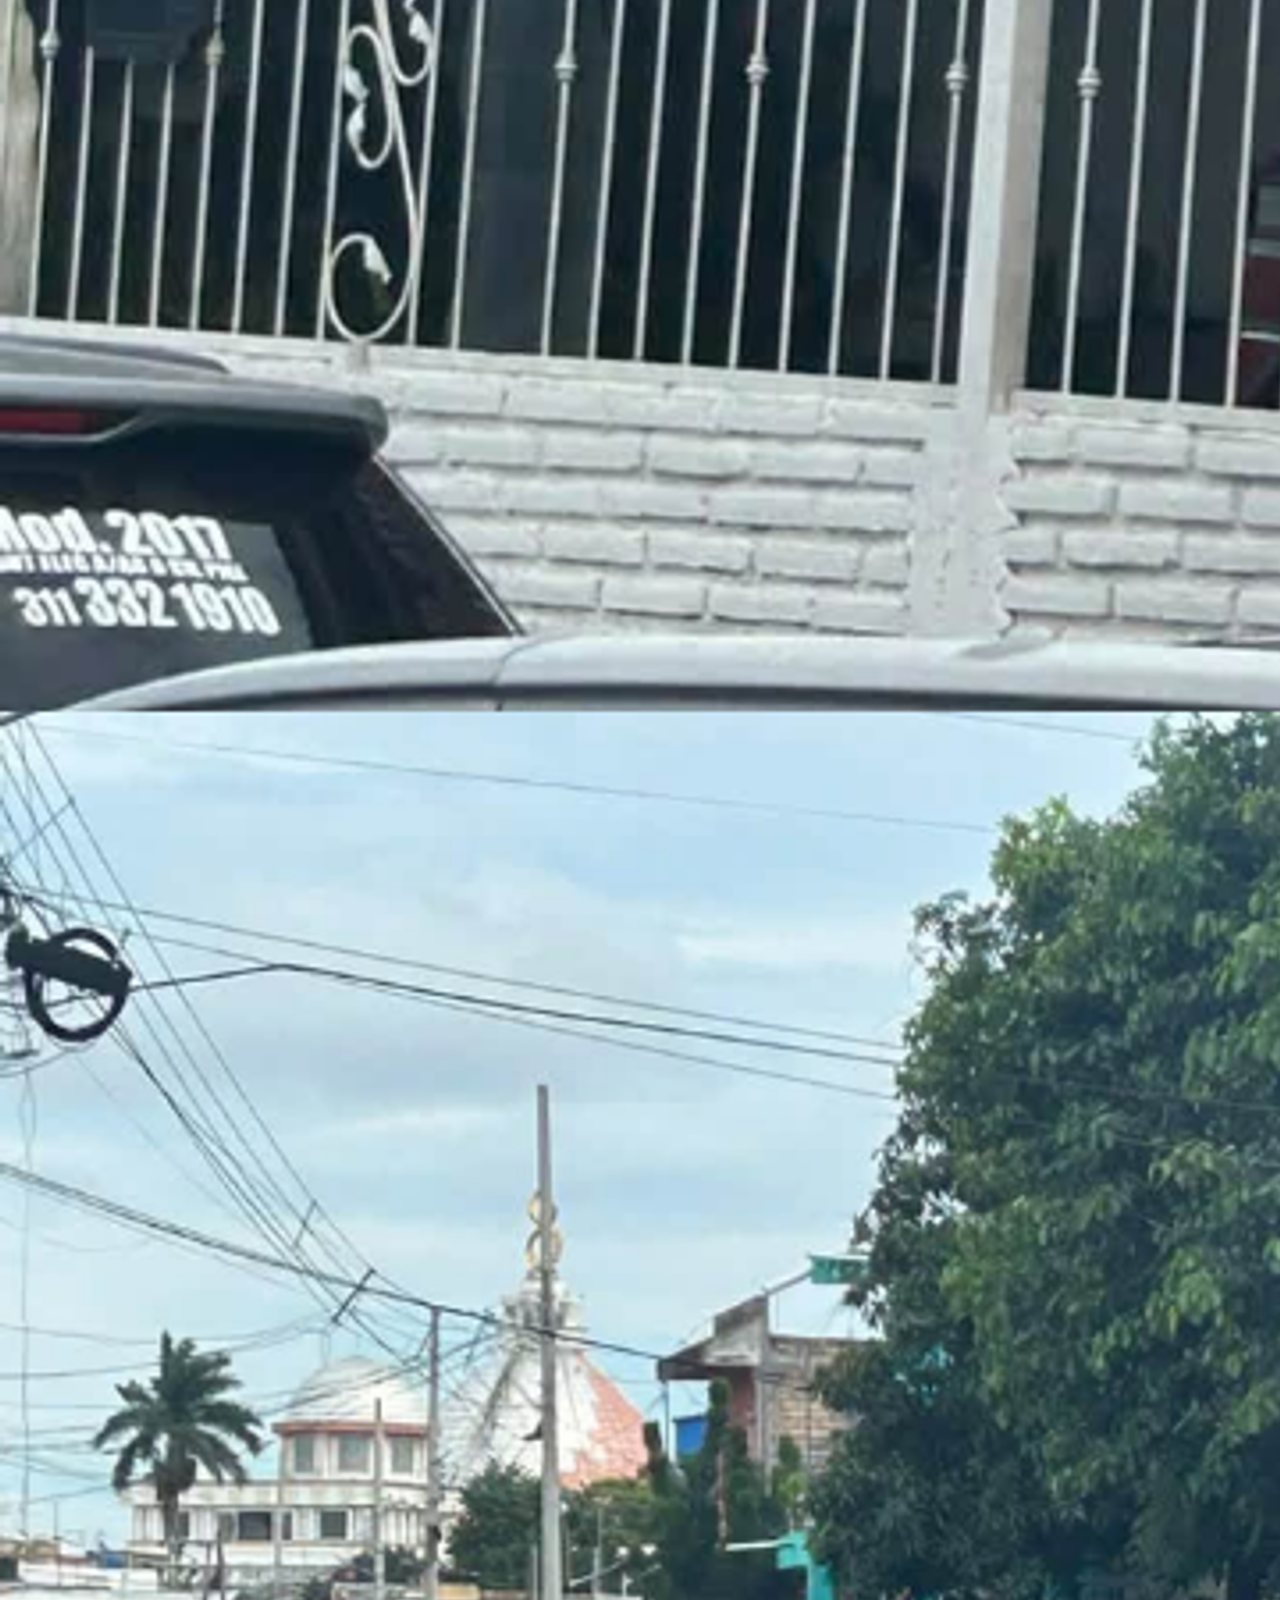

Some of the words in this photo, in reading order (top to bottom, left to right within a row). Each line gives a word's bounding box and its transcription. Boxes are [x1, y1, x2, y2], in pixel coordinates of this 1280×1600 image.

[103, 508, 233, 561] 2017
[14, 586, 83, 627] 311
[74, 576, 179, 627] 332
[169, 582, 281, 636] 1910
